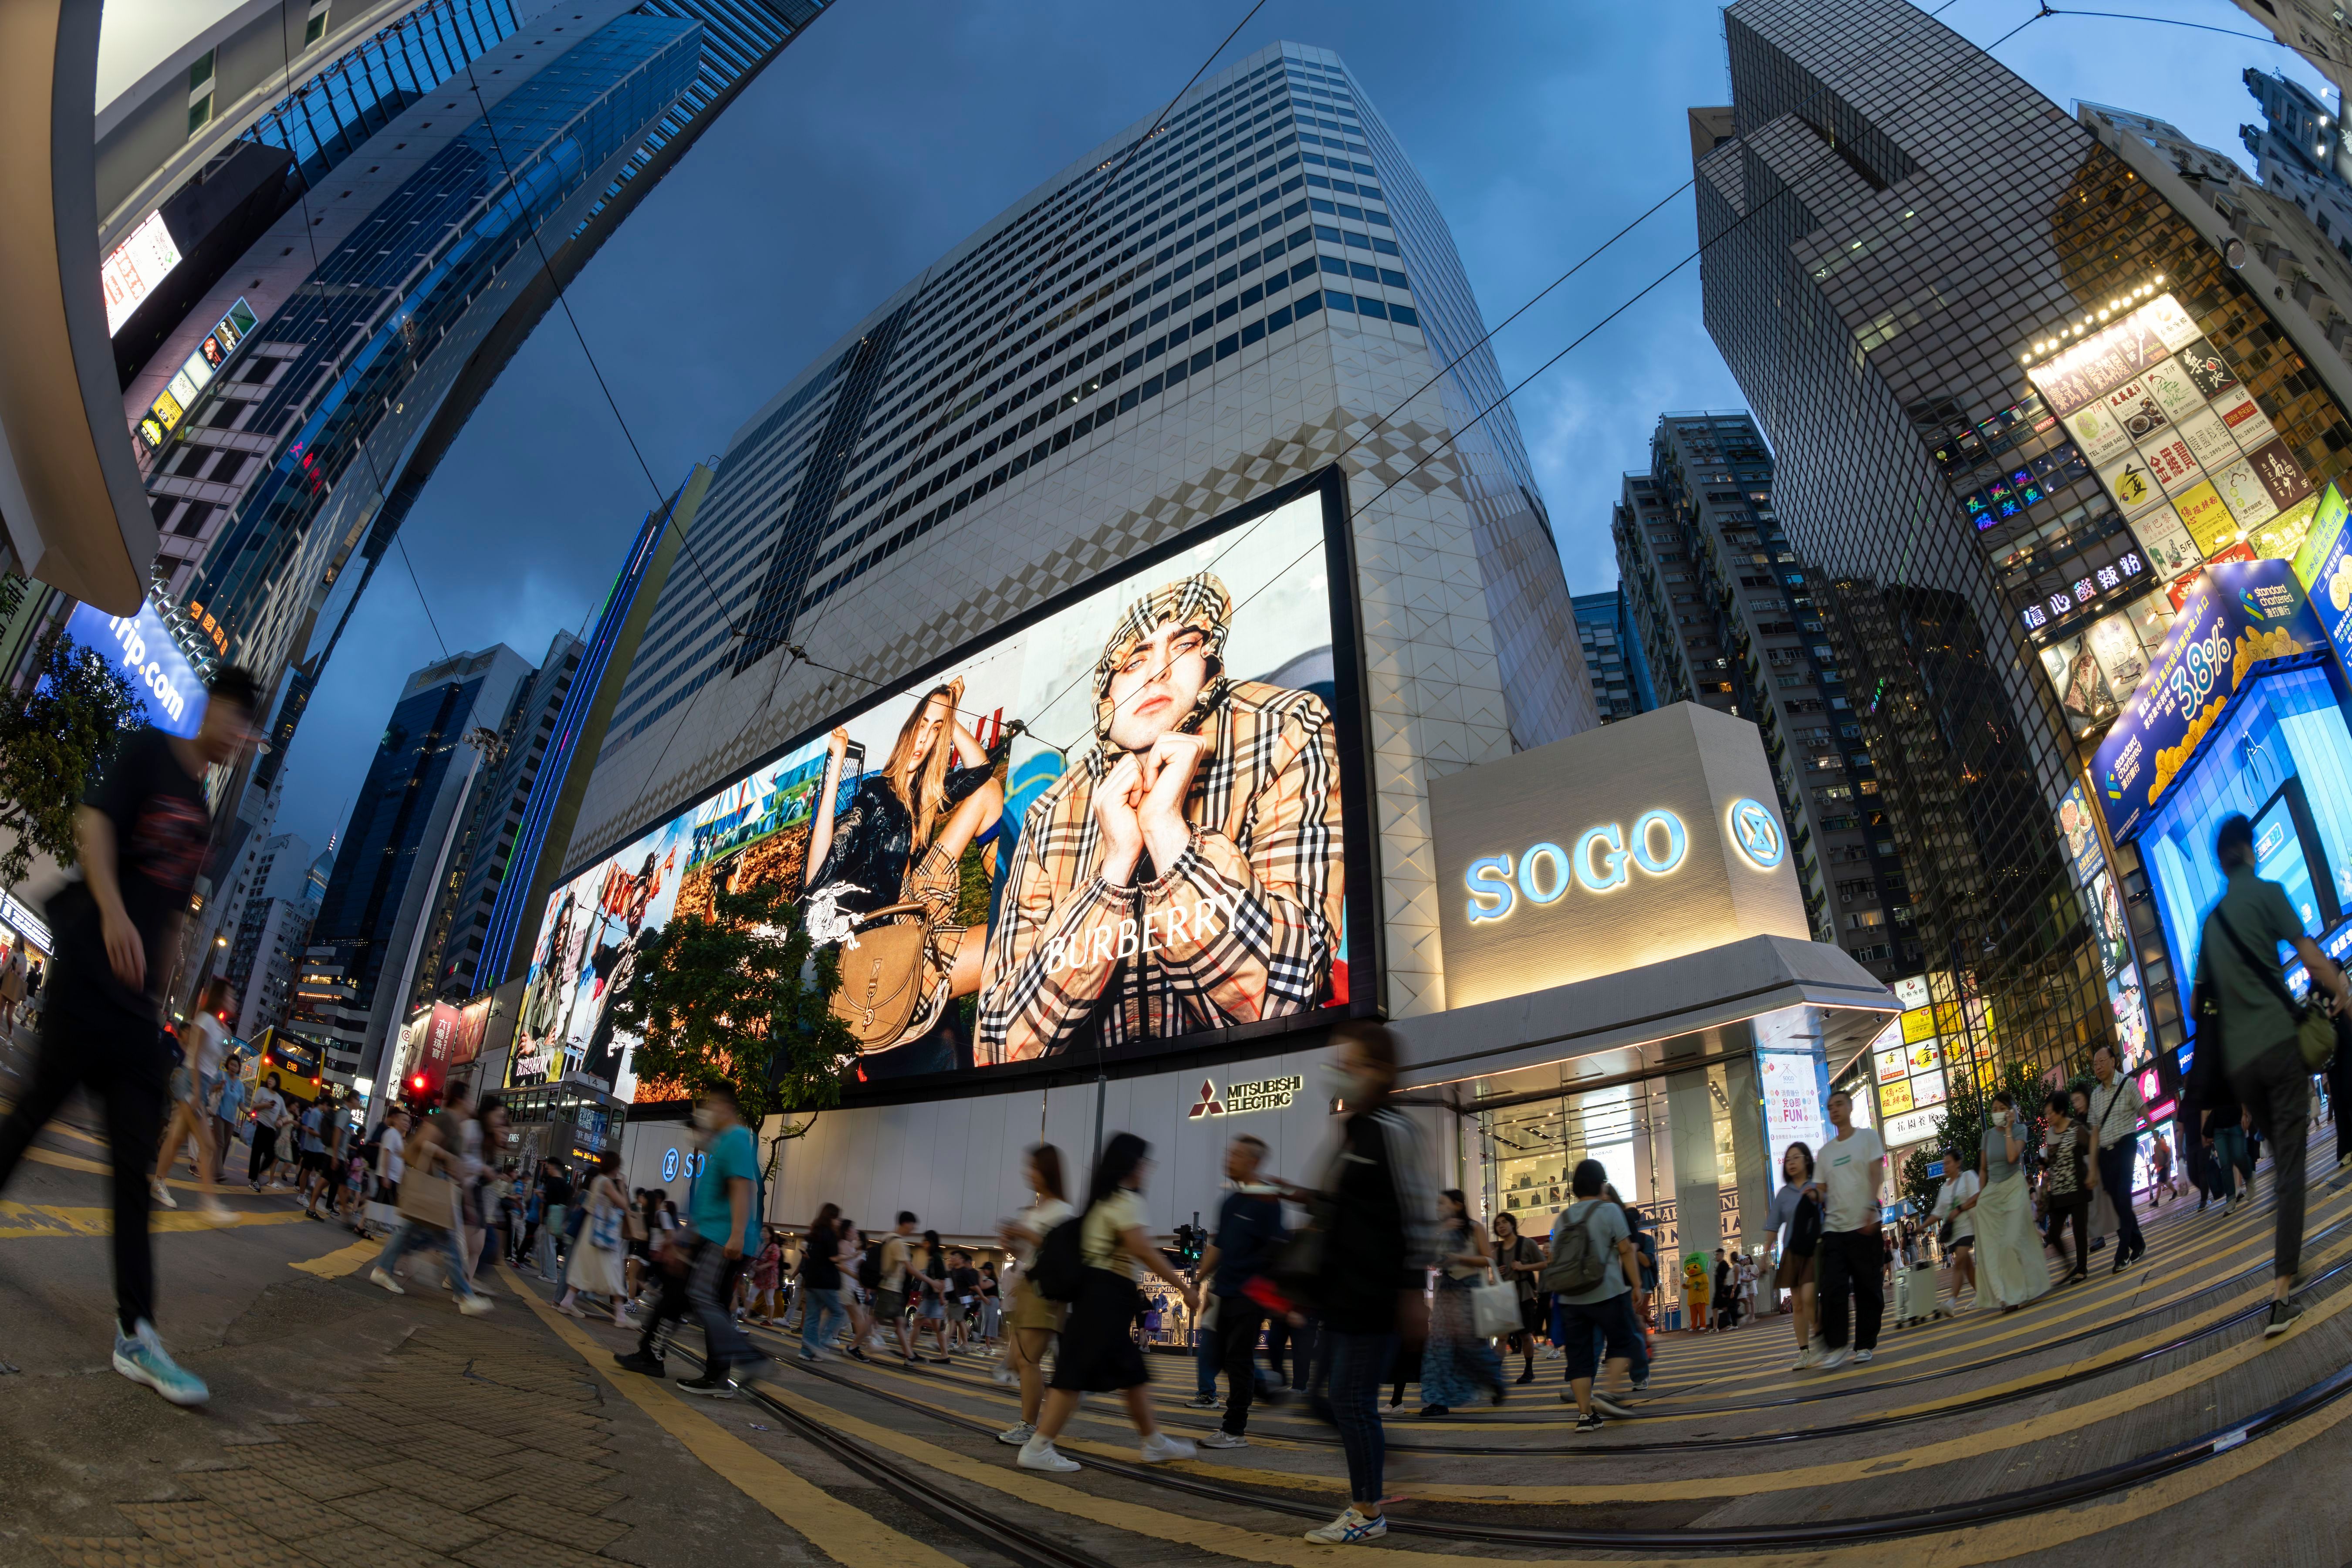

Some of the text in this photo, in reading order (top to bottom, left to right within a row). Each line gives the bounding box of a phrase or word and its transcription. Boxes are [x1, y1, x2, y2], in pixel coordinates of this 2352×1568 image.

[231, 312, 253, 321] GOLDMARK
[2164, 364, 2176, 375] 7/F
[2235, 391, 2246, 401] 6/F
[2089, 402, 2103, 415] 7/F
[2179, 398, 2197, 412] 36188230
[159, 410, 167, 421] 5/F
[2035, 416, 2055, 432] PERFECT
[2255, 419, 2266, 429] 6398
[2102, 439, 2114, 451] 2668
[2114, 435, 2126, 445] 8483
[2222, 440, 2233, 449] 3986
[2150, 440, 2197, 484] 金羅寶
[2119, 463, 2148, 504] 金
[2301, 479, 2309, 488] 5F
[2217, 509, 2227, 522] 5/F
[2142, 512, 2172, 534] 新巴黎
[2180, 540, 2192, 553] 5/F
[2024, 553, 2141, 629] 傷心酸辣粉
[2254, 584, 2288, 597] standard
[2260, 593, 2294, 607] chartered
[2264, 605, 2291, 618] 渣打銀行
[2053, 665, 2061, 673] 3F
[2114, 733, 2138, 771] standard
[2118, 741, 2142, 780] chartered
[2121, 761, 2140, 791] 渣打銀行
[1465, 809, 1686, 922] SOGO
[836, 885, 854, 894] PRORSUM
[1044, 888, 1247, 975] BURBERRY
[2102, 957, 2108, 968] 3F
[432, 1019, 448, 1059] 六福珠寶
[1922, 1044, 1936, 1064] 金
[287, 1061, 297, 1072] E11B
[516, 1054, 551, 1077] BURBERRY
[588, 1075, 598, 1087] 14
[1227, 1076, 1301, 1098] MITSUBISHI
[1886, 1086, 1904, 1097] 傷心
[1227, 1092, 1291, 1112] ELECTRIC
[1882, 1094, 1910, 1107] 酸辣粉
[1783, 1109, 1803, 1122] FUN
